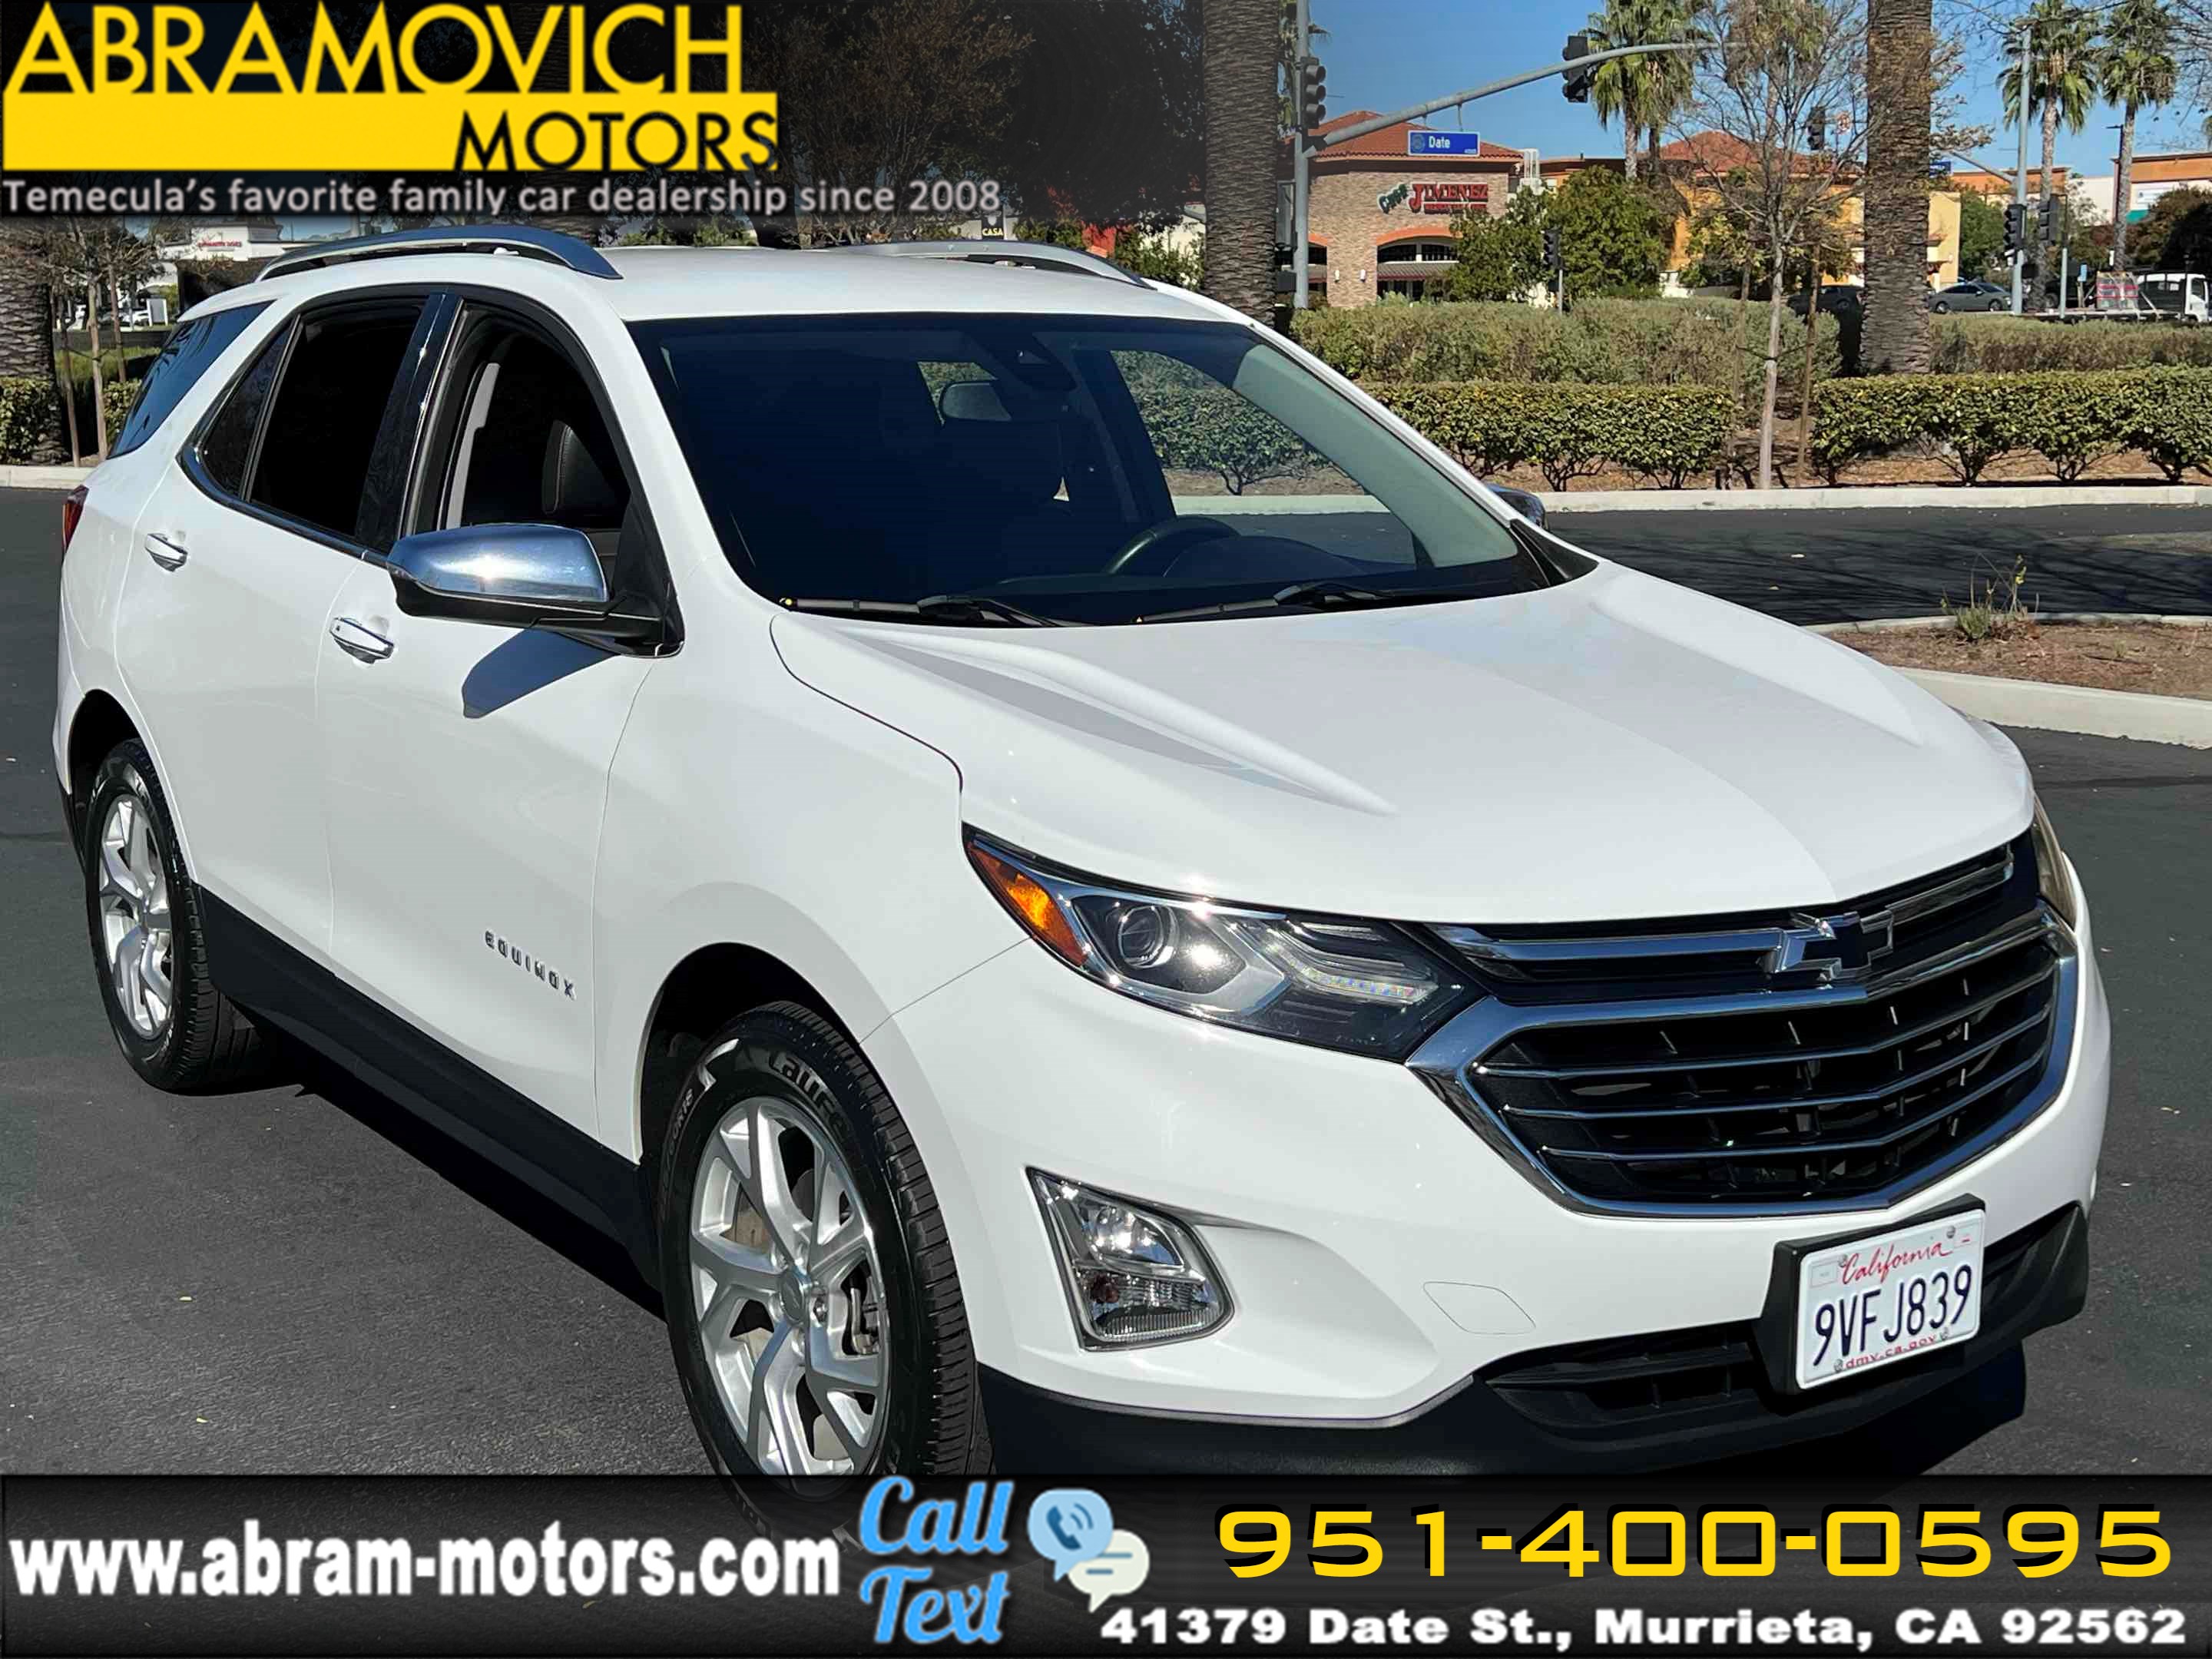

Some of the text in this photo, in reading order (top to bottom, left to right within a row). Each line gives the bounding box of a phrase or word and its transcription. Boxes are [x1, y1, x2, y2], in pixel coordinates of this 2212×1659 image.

[1429, 135, 1451, 148] Date
[982, 227, 1004, 237] CASA
[485, 930, 576, 1001] EQUINOX
[1842, 1243, 1953, 1285] California
[1813, 1264, 1972, 1366] 9VFJ839
[1845, 1334, 1937, 1370] dmv.ca.gov
